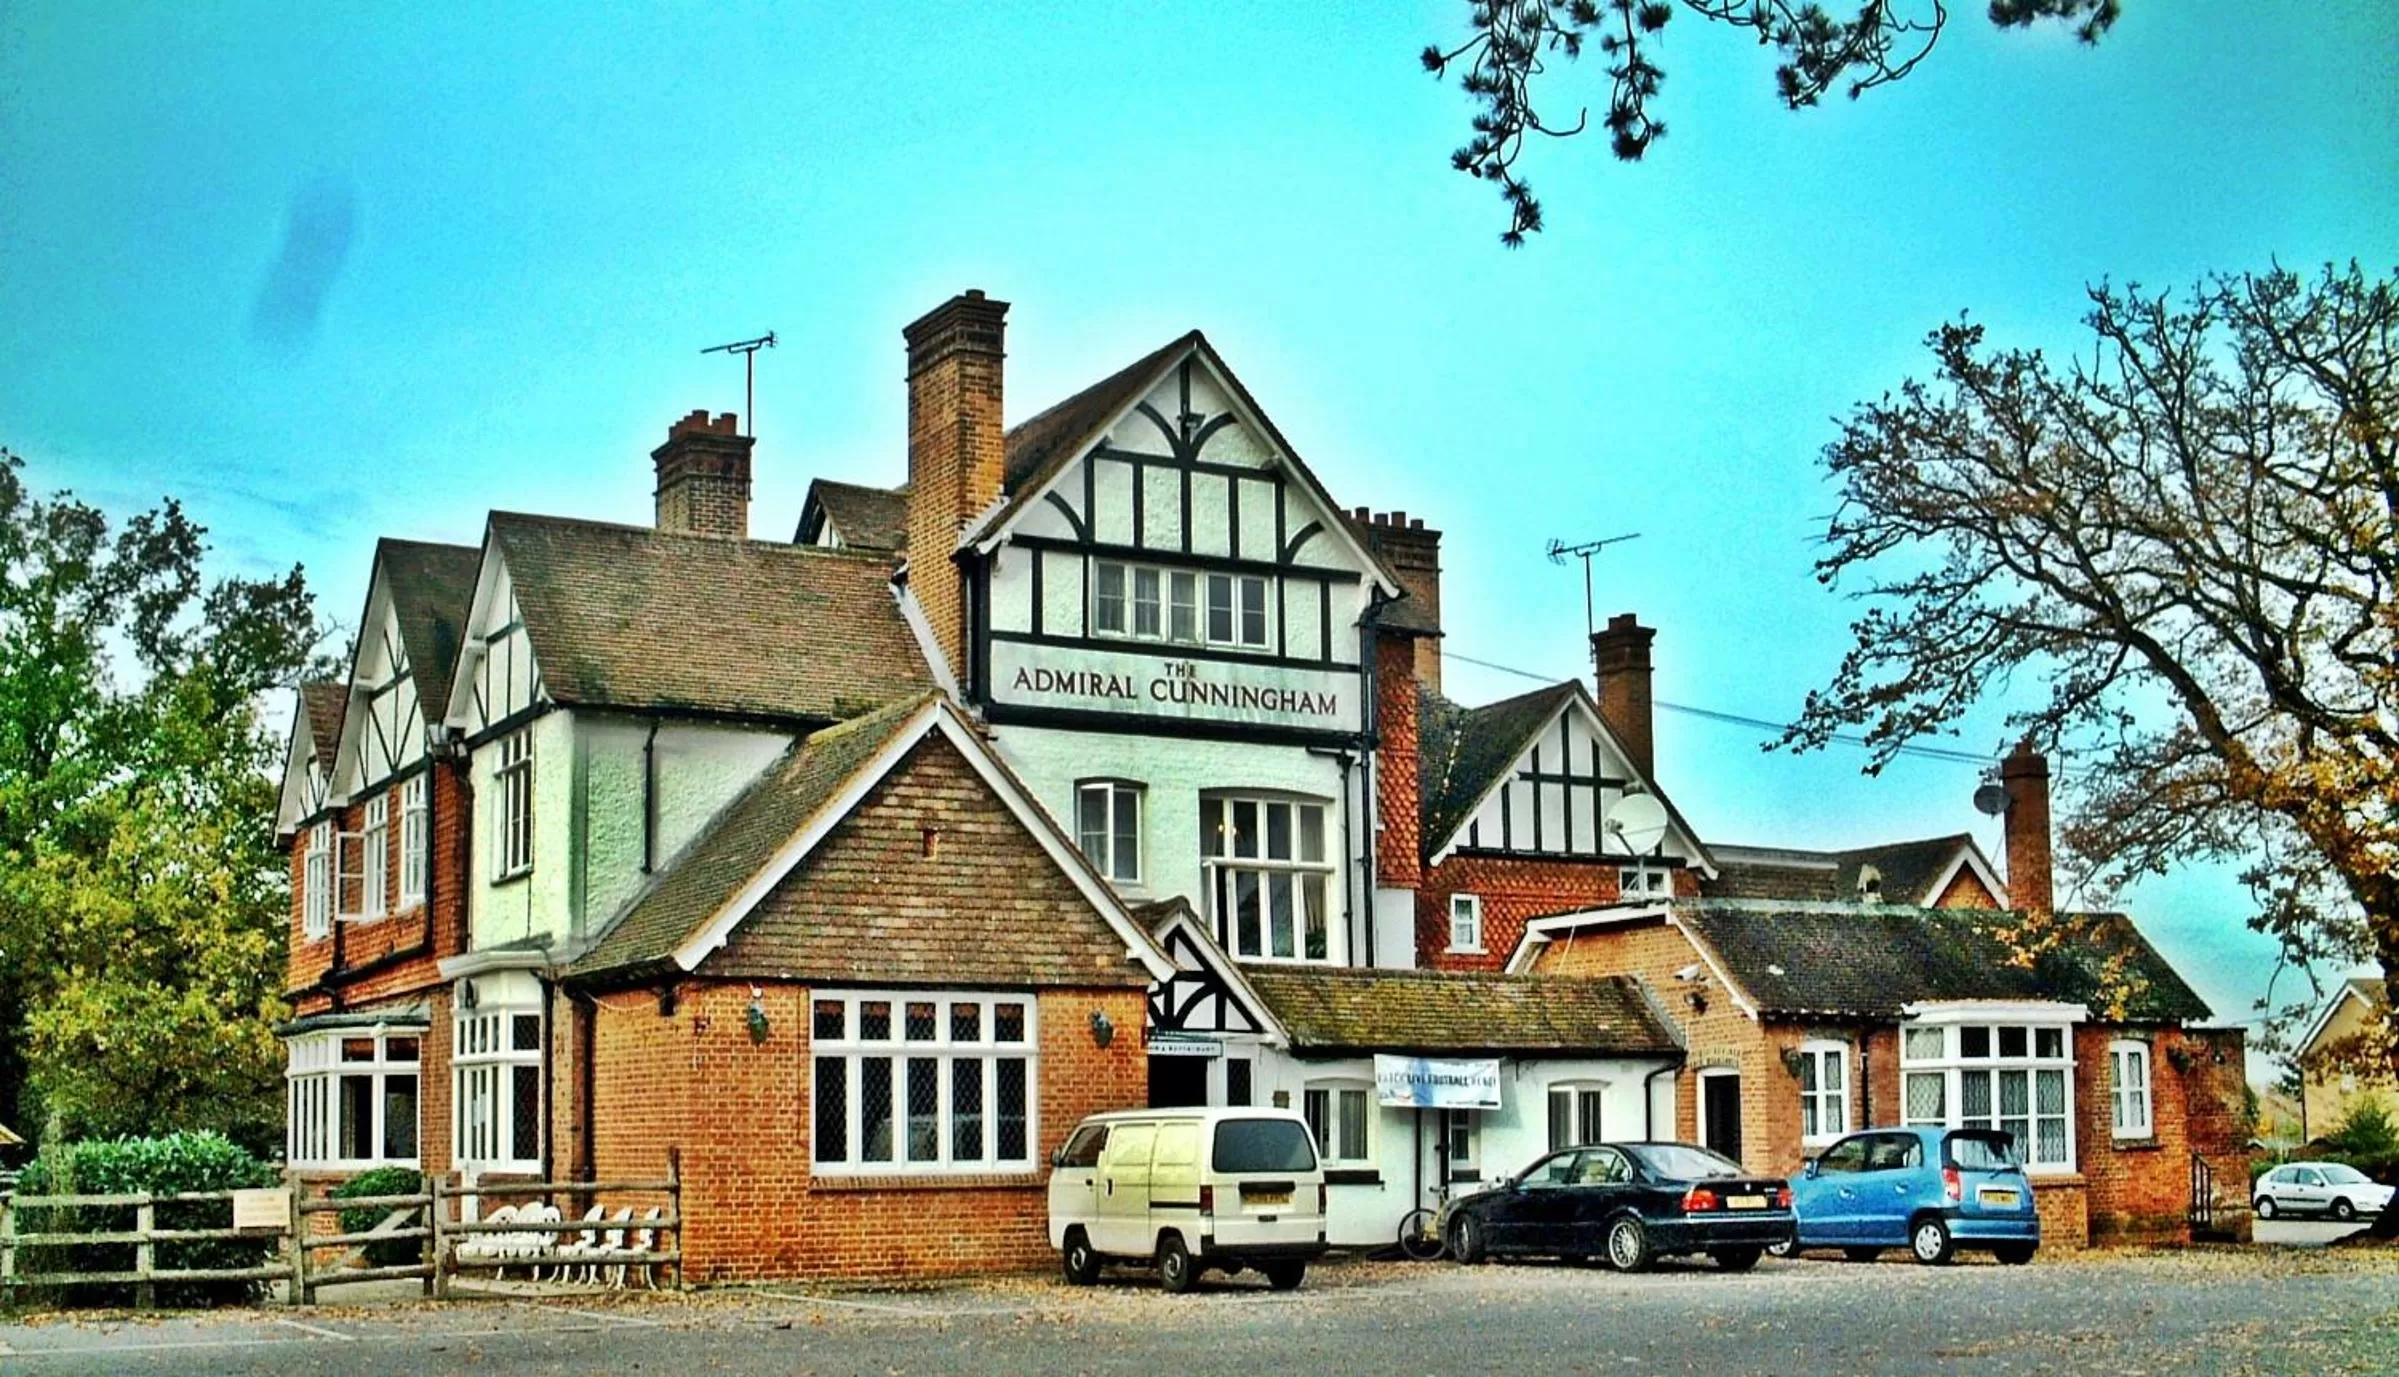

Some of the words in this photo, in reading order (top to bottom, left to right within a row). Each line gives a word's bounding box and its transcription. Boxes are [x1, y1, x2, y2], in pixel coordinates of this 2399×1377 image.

[1164, 661, 1197, 678] THE
[1013, 666, 1138, 700] ADMIRAL
[1150, 678, 1337, 716] CUNNINGHAM
